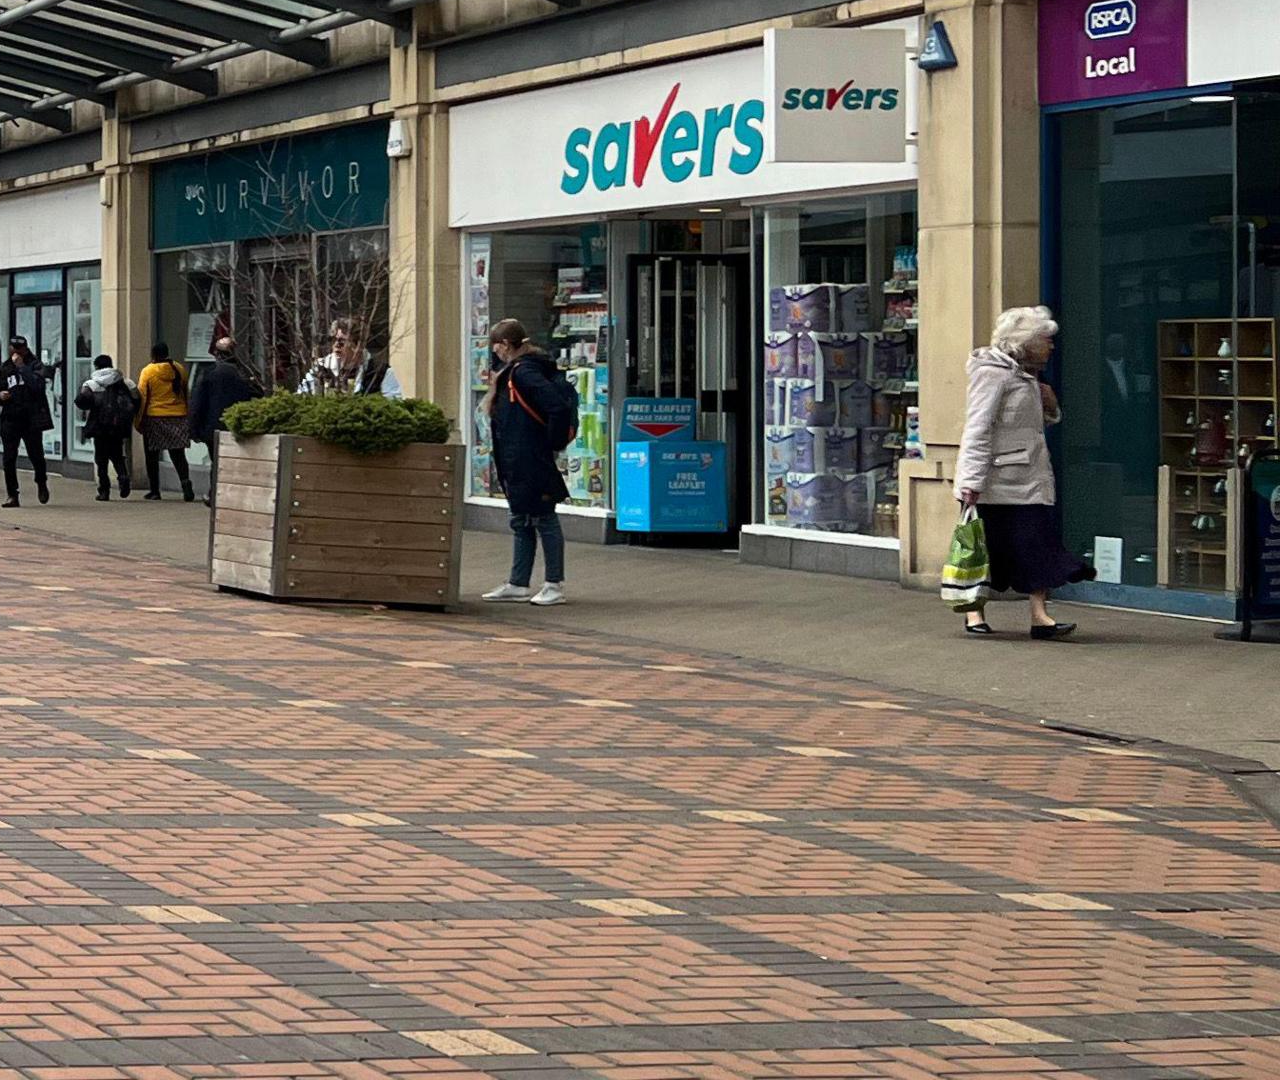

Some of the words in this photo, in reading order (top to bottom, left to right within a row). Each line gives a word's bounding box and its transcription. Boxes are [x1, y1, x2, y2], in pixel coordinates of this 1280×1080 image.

[1090, 7, 1131, 29] RSPCA
[1085, 47, 1136, 78] Local
[782, 79, 899, 111] savers
[560, 82, 765, 195] savers
[196, 161, 359, 215] SURVIVOR
[627, 404, 651, 413] FREE
[653, 404, 692, 413] LEAFLET
[676, 472, 698, 481] FREE
